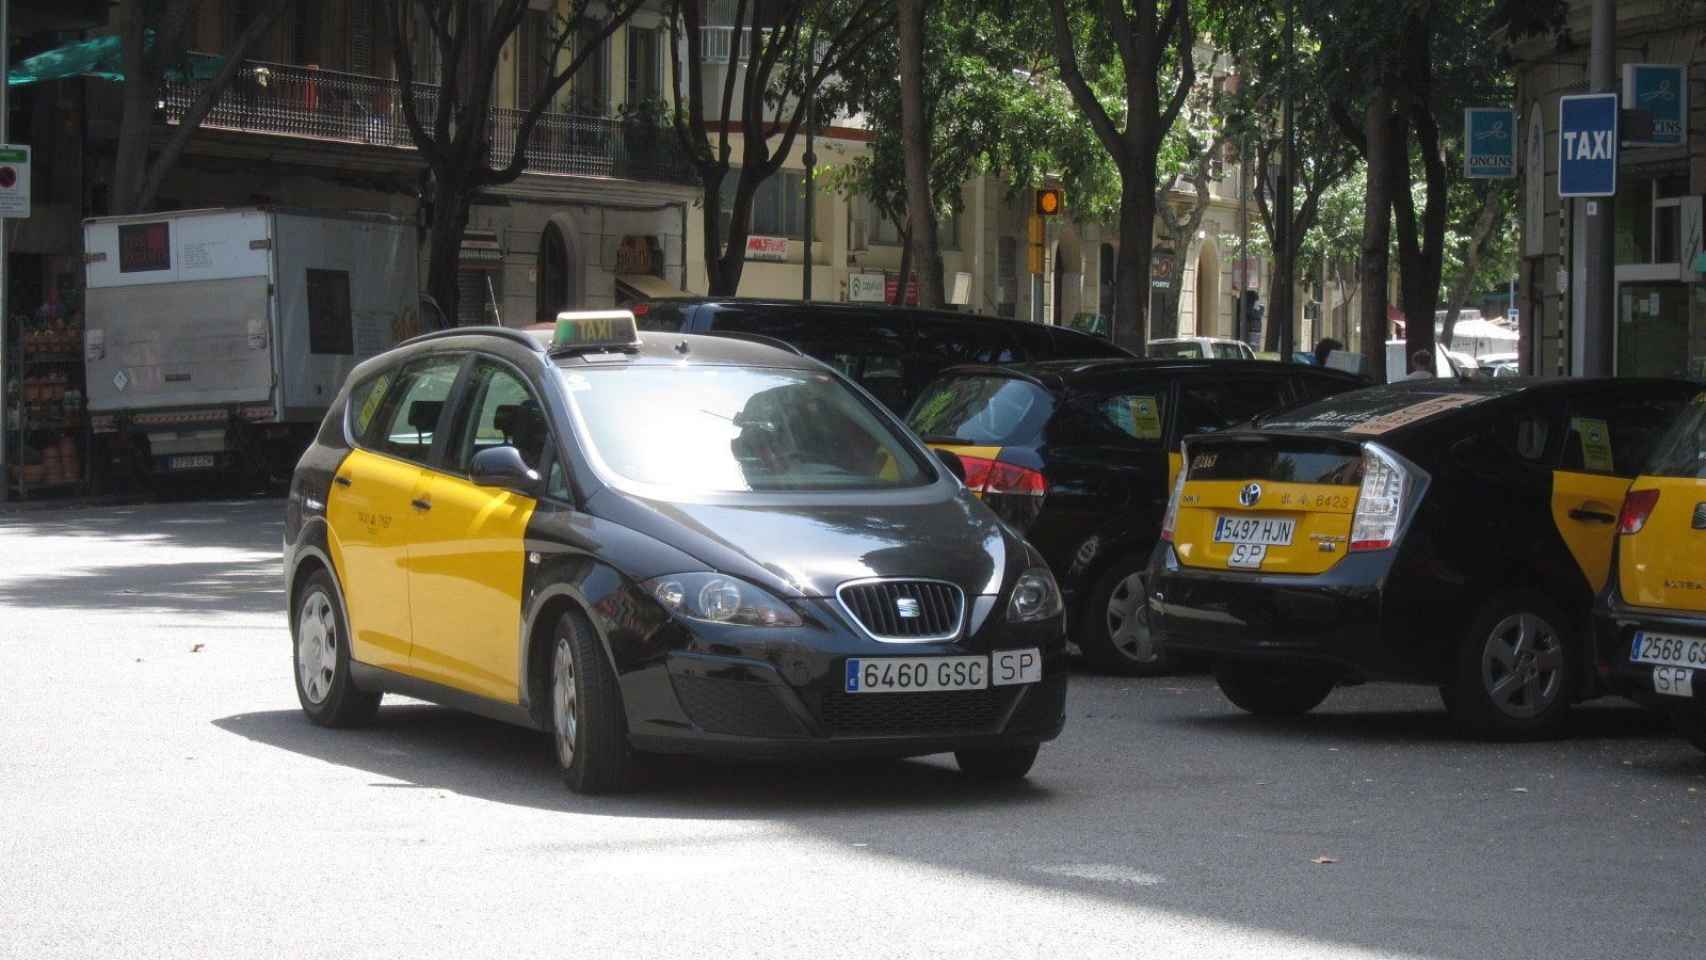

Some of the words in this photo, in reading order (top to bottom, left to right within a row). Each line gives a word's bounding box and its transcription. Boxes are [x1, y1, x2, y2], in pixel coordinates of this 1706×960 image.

[1563, 129, 1613, 161] TAXI
[579, 319, 613, 342] TAXI
[1224, 519, 1260, 541] 5497
[1262, 519, 1292, 543] HJN
[1232, 544, 1262, 564] SP
[1642, 637, 1683, 661] 2568
[864, 663, 928, 688] 6460
[937, 661, 982, 686] GSC
[1000, 653, 1034, 681] SP
[1658, 667, 1687, 691] SP
